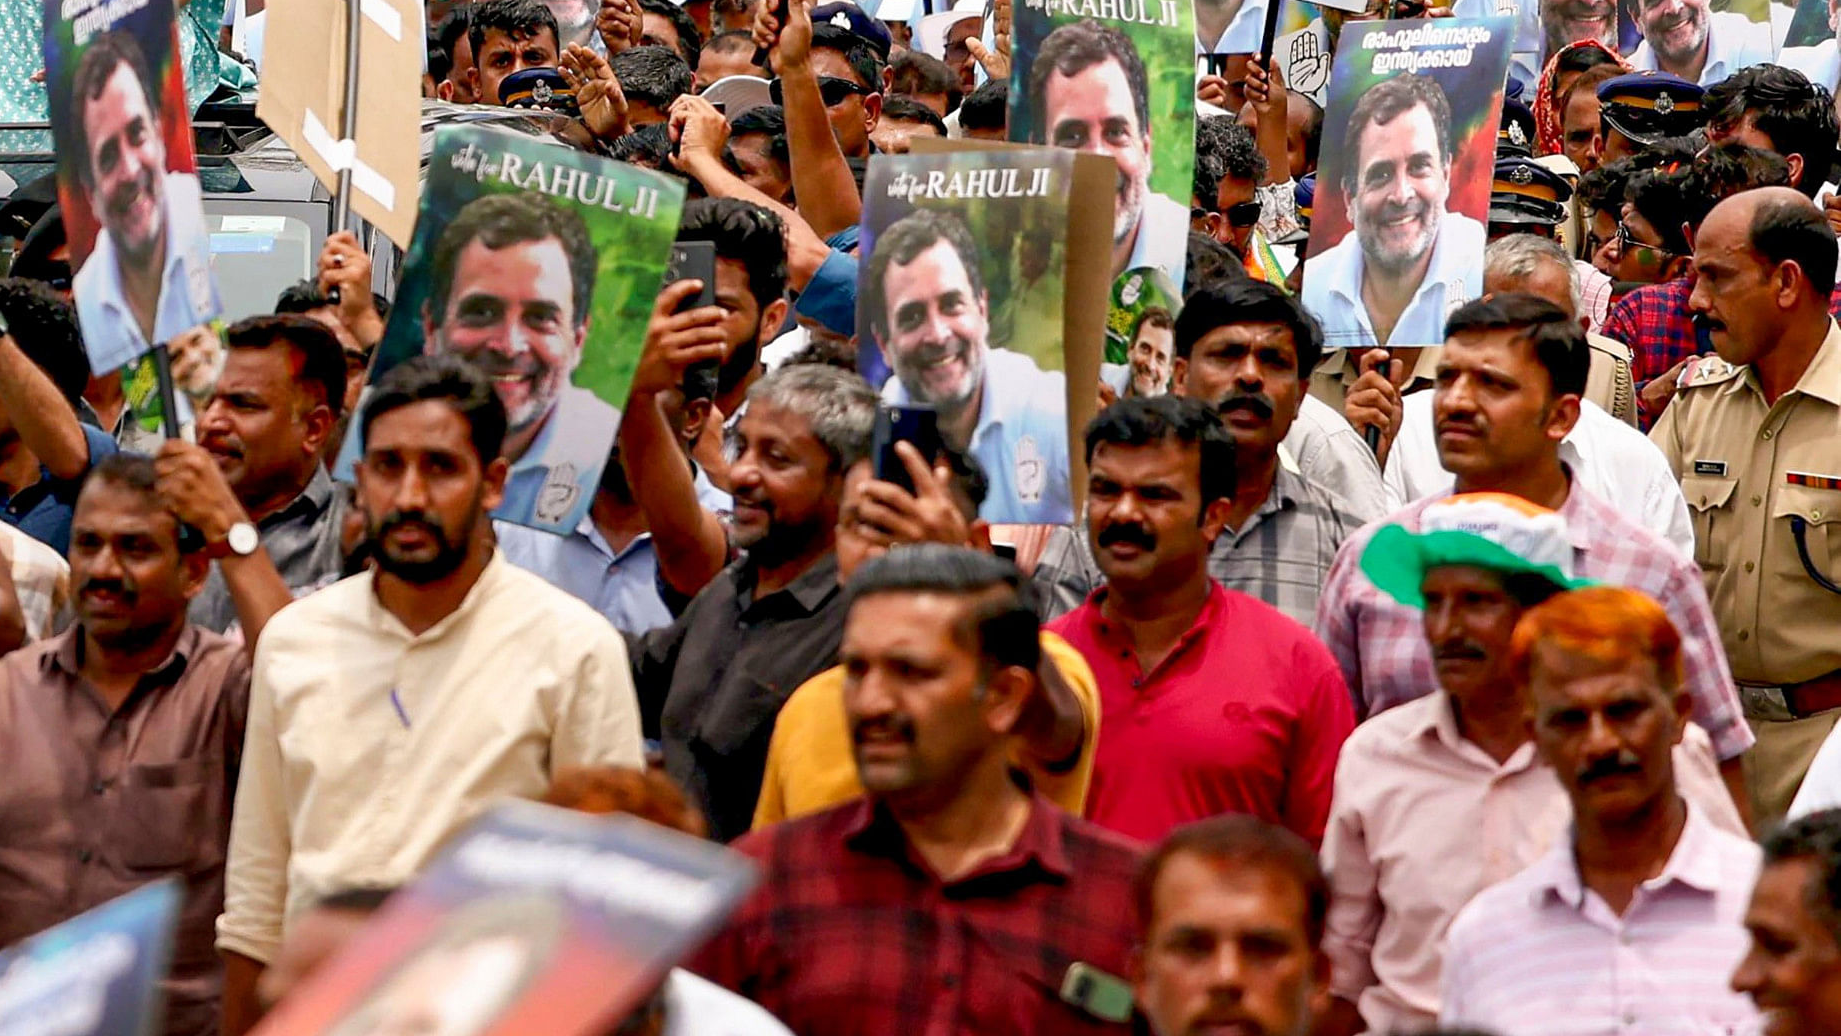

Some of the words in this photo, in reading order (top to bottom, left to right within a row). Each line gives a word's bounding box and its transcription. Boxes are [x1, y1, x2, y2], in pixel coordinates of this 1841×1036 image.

[1361, 23, 1491, 50] രാഹുലിനൊപ്പം
[1371, 47, 1474, 75] ഇന്ത്യക്കായ്
[499, 151, 623, 213] RAHUL
[629, 185, 659, 220] JI
[925, 168, 1025, 199] RAHUL
[1027, 167, 1051, 197] JI
